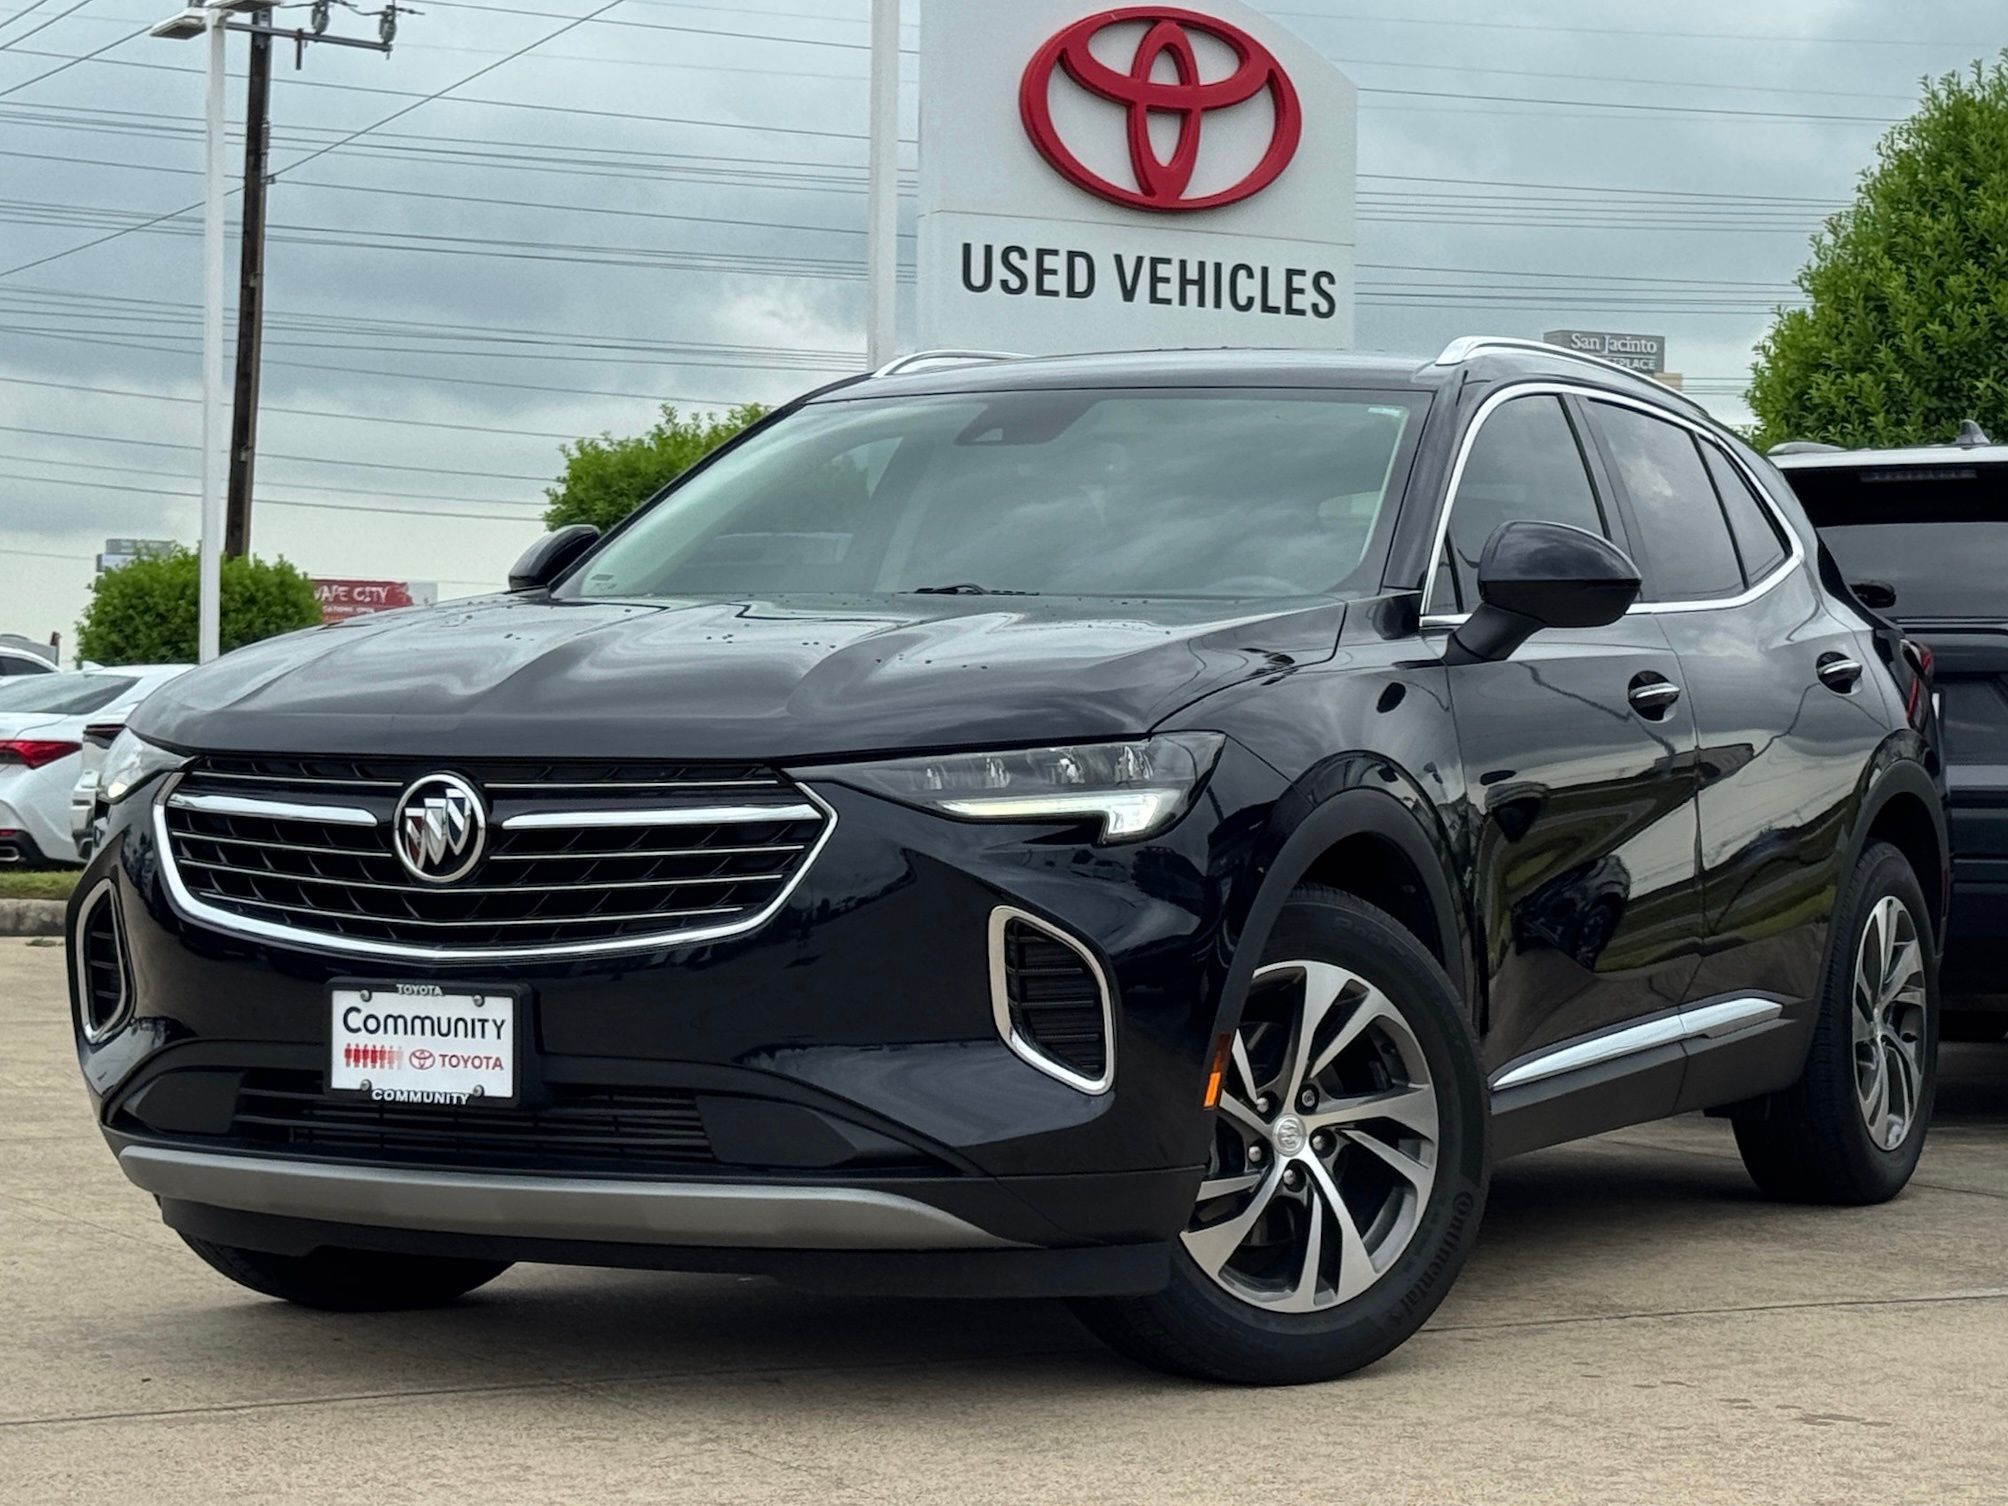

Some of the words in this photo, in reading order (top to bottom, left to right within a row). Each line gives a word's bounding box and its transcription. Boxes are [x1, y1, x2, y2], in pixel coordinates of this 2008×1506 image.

[961, 242, 1096, 300] USED
[1112, 252, 1337, 319] VEHICLES
[1570, 332, 1600, 350] San
[1603, 335, 1658, 354] Jacinto
[353, 586, 391, 603] CITY
[396, 983, 445, 997] TOYOTA
[438, 1053, 505, 1071] TOYOTA
[371, 1088, 472, 1105] COMMUNITY
[1401, 1190, 1475, 1318] Continental
